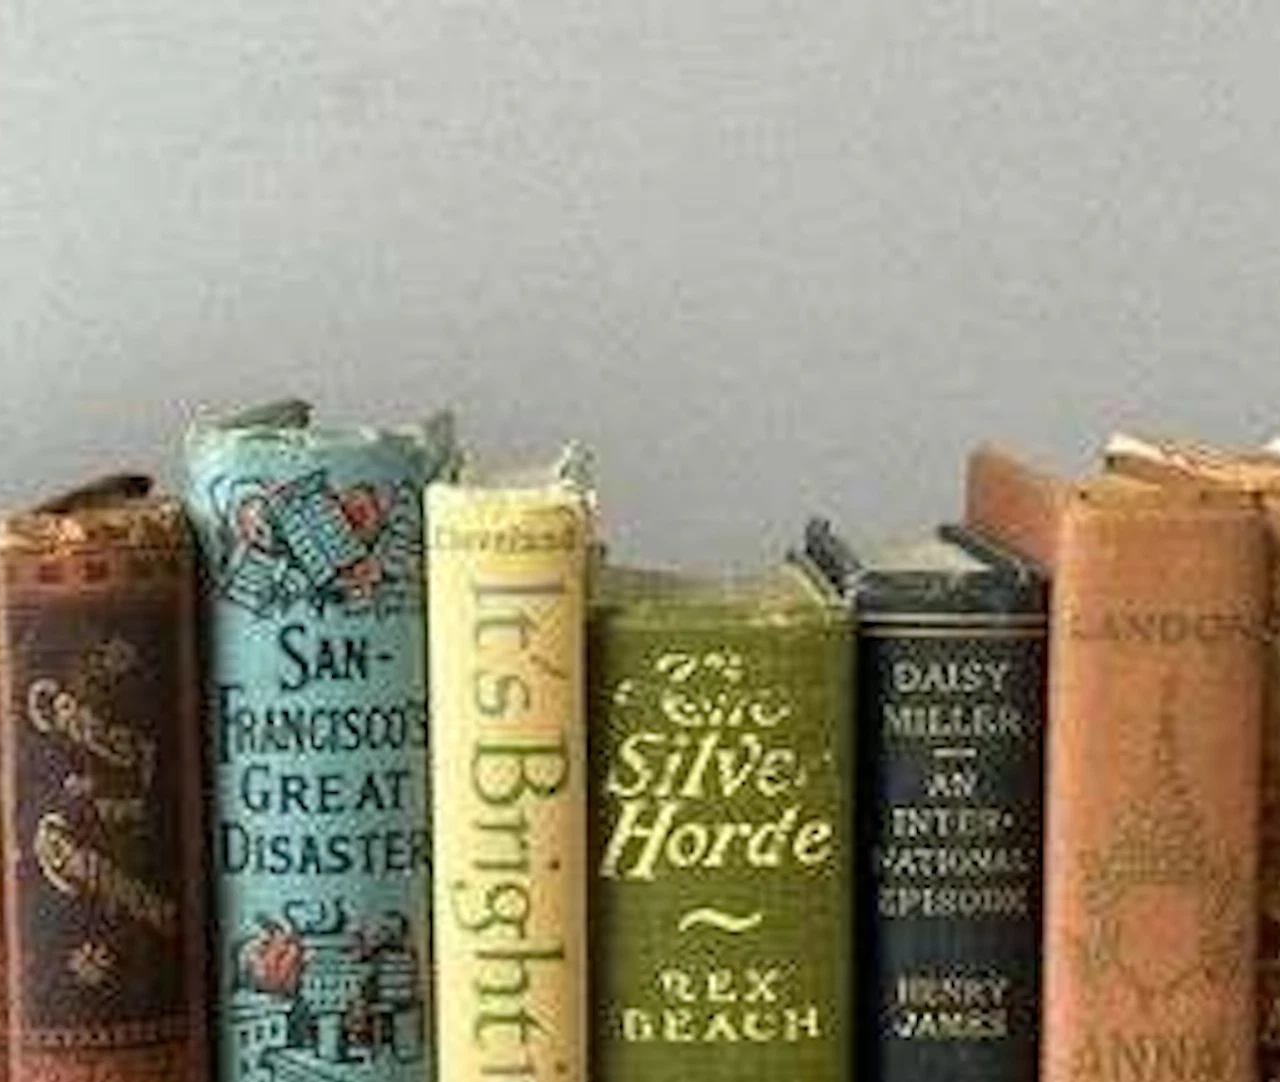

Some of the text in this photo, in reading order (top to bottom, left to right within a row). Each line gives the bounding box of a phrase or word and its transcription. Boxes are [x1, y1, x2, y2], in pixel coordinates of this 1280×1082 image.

[275, 621, 395, 690] SAN-
[892, 661, 1010, 693] DAISY
[882, 703, 1023, 739] MILLER
[240, 765, 412, 815] GREAT
[220, 822, 431, 878] DISASTER
[598, 799, 834, 881] Horde
[449, 727, 571, 1046] Bright
[658, 966, 780, 1003] REX
[620, 1005, 821, 1043] BEACH
[1070, 1034, 1222, 1082] ANNA
